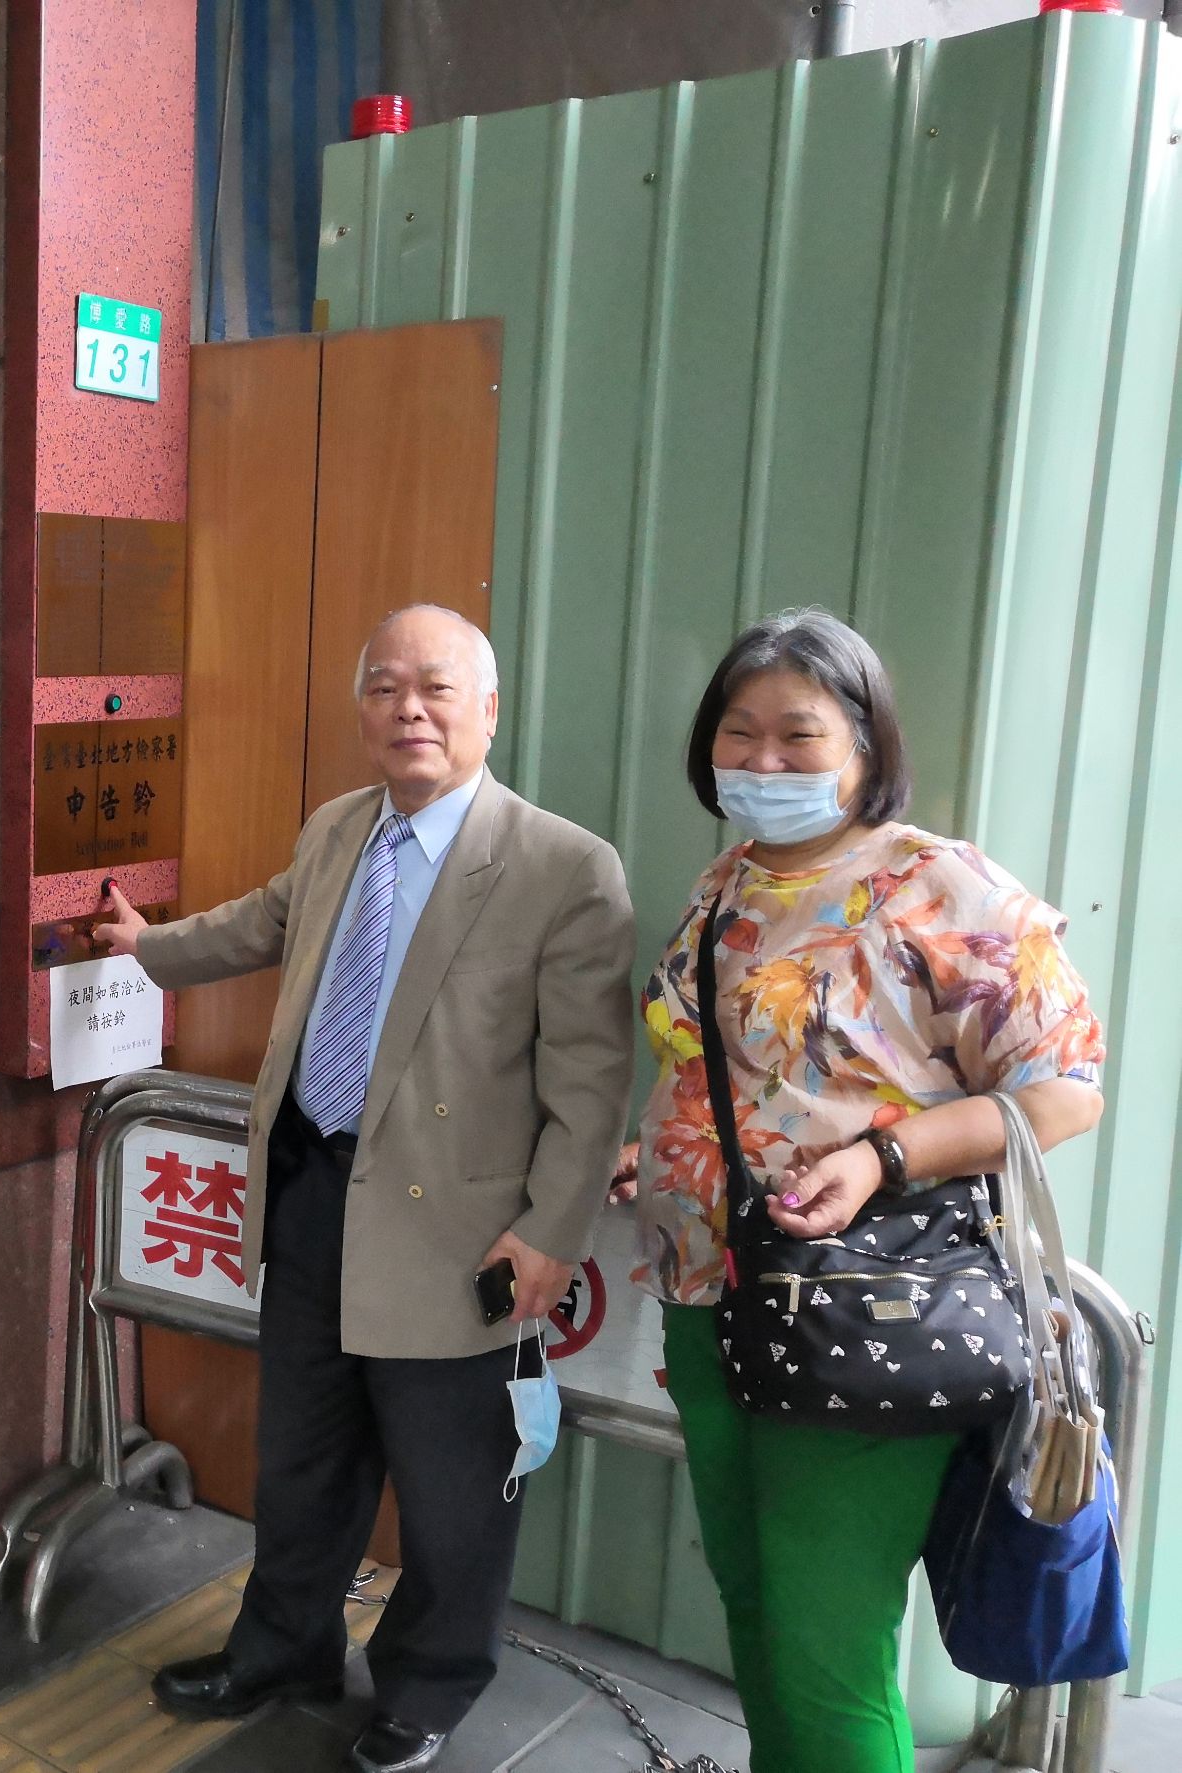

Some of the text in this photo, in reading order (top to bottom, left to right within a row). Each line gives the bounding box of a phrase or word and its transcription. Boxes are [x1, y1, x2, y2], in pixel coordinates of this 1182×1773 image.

[89, 300, 151, 335] 博愛路
[86, 338, 151, 387] 131
[66, 780, 156, 822] 申告鈴
[67, 977, 147, 1007] 夜間如需洽公
[87, 1010, 126, 1032] 請按鈴
[140, 1151, 246, 1288] 禁
